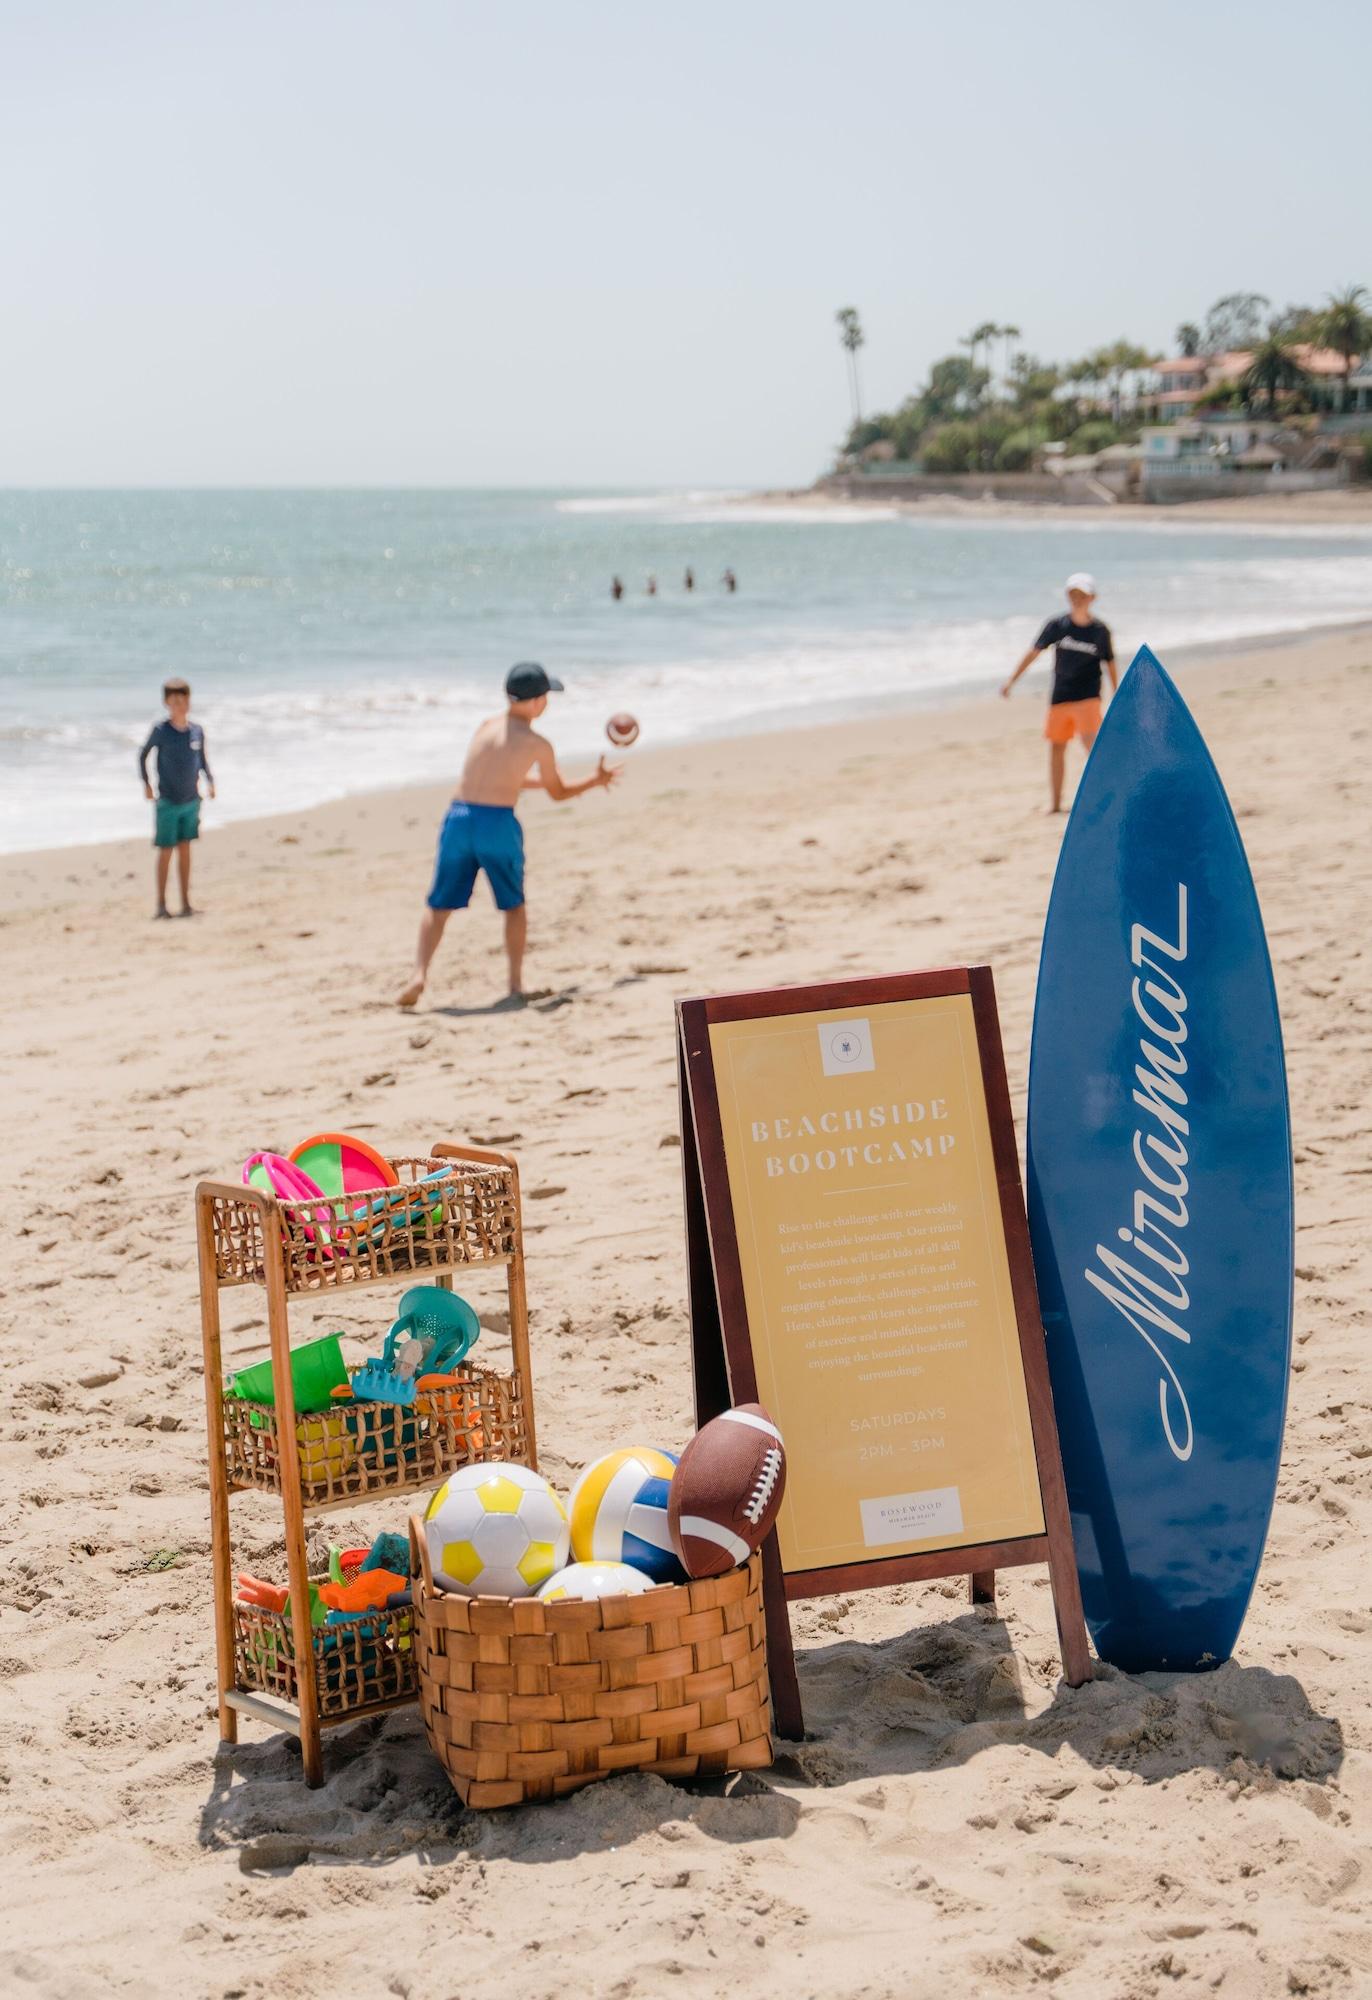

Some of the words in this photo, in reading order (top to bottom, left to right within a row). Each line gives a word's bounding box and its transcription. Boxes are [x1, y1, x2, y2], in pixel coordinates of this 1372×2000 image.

[751, 1099, 949, 1143] BEACHSIDE
[765, 1135, 957, 1178] BOOTCAMP
[1085, 882, 1192, 1461] Miramar
[814, 1218, 830, 1228] the
[832, 1212, 879, 1229] challenge
[880, 1209, 903, 1220] with
[929, 1220, 963, 1233] trained
[784, 1255, 848, 1275] professionals
[850, 1253, 868, 1263] will
[870, 1249, 890, 1261] lead
[892, 1246, 912, 1257] kids
[914, 1244, 925, 1255] of
[926, 1243, 938, 1253] all
[940, 1240, 960, 1251] skill
[798, 1277, 825, 1290] levels
[828, 1272, 868, 1289] through
[877, 1268, 905, 1279] series
[906, 1265, 918, 1275] of
[937, 1261, 956, 1271] and
[780, 1299, 825, 1315] engaging
[931, 1280, 949, 1292] and
[816, 1313, 857, 1327] children
[858, 1310, 878, 1321] will
[879, 1306, 904, 1318] learn
[906, 1304, 923, 1315] the
[925, 1297, 979, 1315] importance
[804, 1337, 817, 1349] of
[818, 1334, 856, 1347] exercise
[859, 1330, 877, 1341] and
[879, 1322, 938, 1339] mindfulness
[938, 1318, 966, 1330] while
[807, 1353, 851, 1370] enjoying
[853, 1351, 869, 1362] the
[871, 1344, 914, 1359] beautiful
[916, 1337, 968, 1353] beachfront
[849, 1407, 945, 1431] SATURDAYS
[858, 1444, 893, 1460] 2PM
[911, 1436, 944, 1452] 3PM
[880, 1501, 942, 1516] ROSEWOOD
